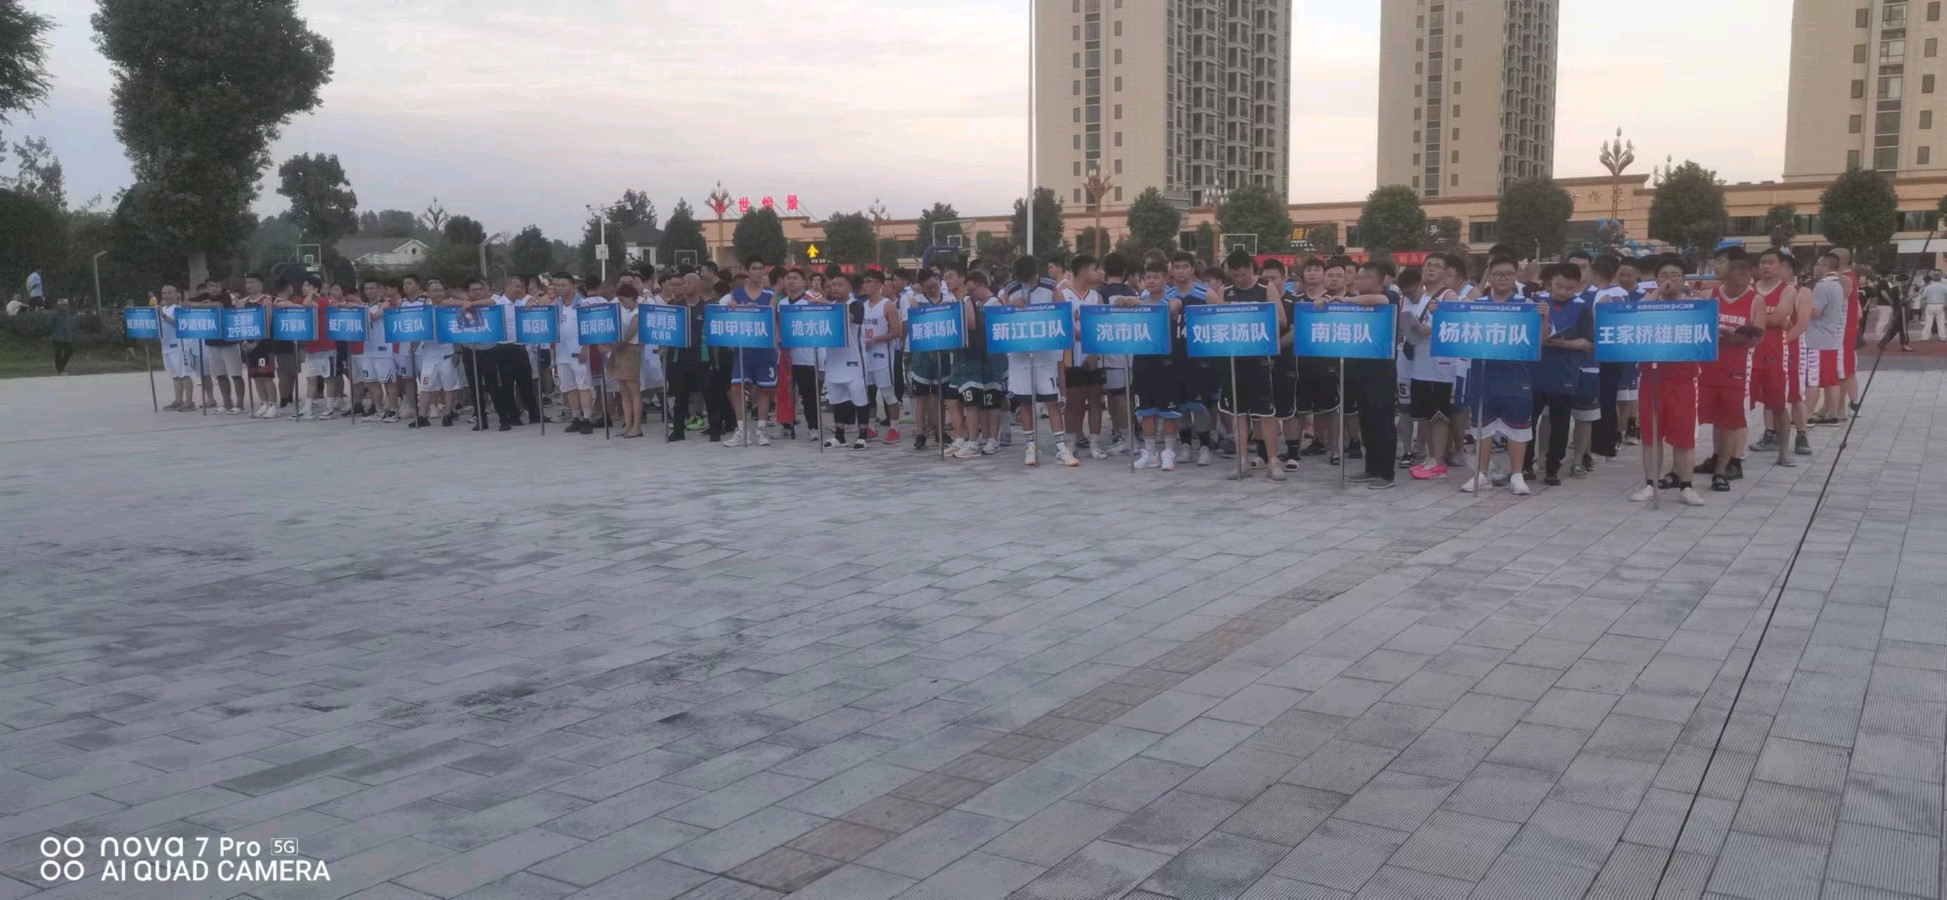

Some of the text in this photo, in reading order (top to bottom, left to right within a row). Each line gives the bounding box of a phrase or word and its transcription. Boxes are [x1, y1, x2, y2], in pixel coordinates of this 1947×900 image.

[280, 319, 306, 333] 万家队
[393, 318, 424, 333] 八宝队
[580, 318, 615, 336] 街河市队
[646, 312, 677, 331] 裁判员
[710, 319, 768, 337] 卸甲坪队
[791, 319, 833, 337] 洈水队
[912, 318, 958, 341] 斯家场队
[992, 319, 1066, 341] 新江口队
[1192, 322, 1270, 344] 刘家场队
[1311, 322, 1373, 344] 南海队
[1438, 321, 1530, 346] 杨林市队
[1598, 324, 1713, 345] 王家桥雄鹿队
[768, 366, 775, 378] 3
